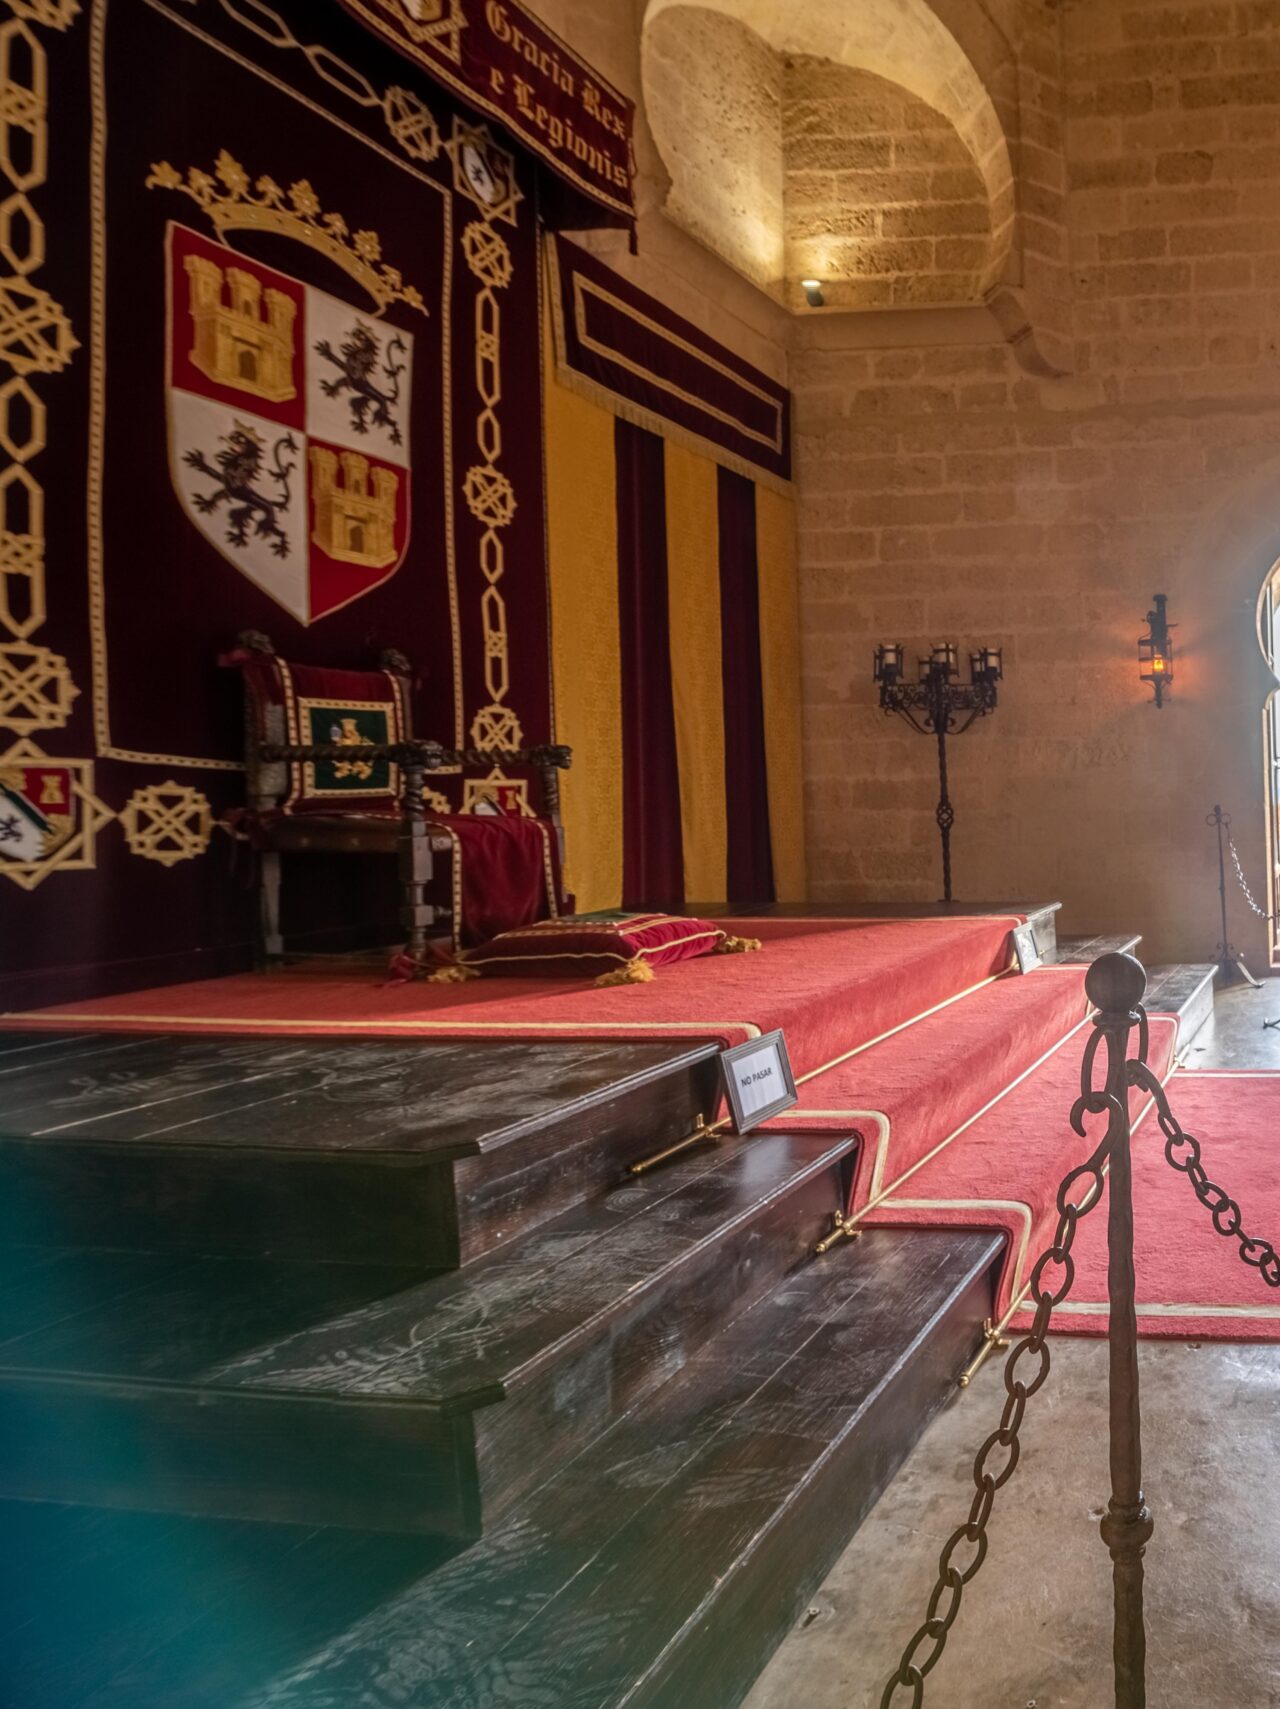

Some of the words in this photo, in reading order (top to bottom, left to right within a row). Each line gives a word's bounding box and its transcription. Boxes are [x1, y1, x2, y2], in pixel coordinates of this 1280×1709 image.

[485, 0, 574, 97] Gracia
[581, 79, 626, 140] Rex
[489, 67, 505, 95] e
[512, 74, 628, 189] Legionis
[741, 1076, 752, 1088] NO
[752, 1067, 772, 1082] PASAR
